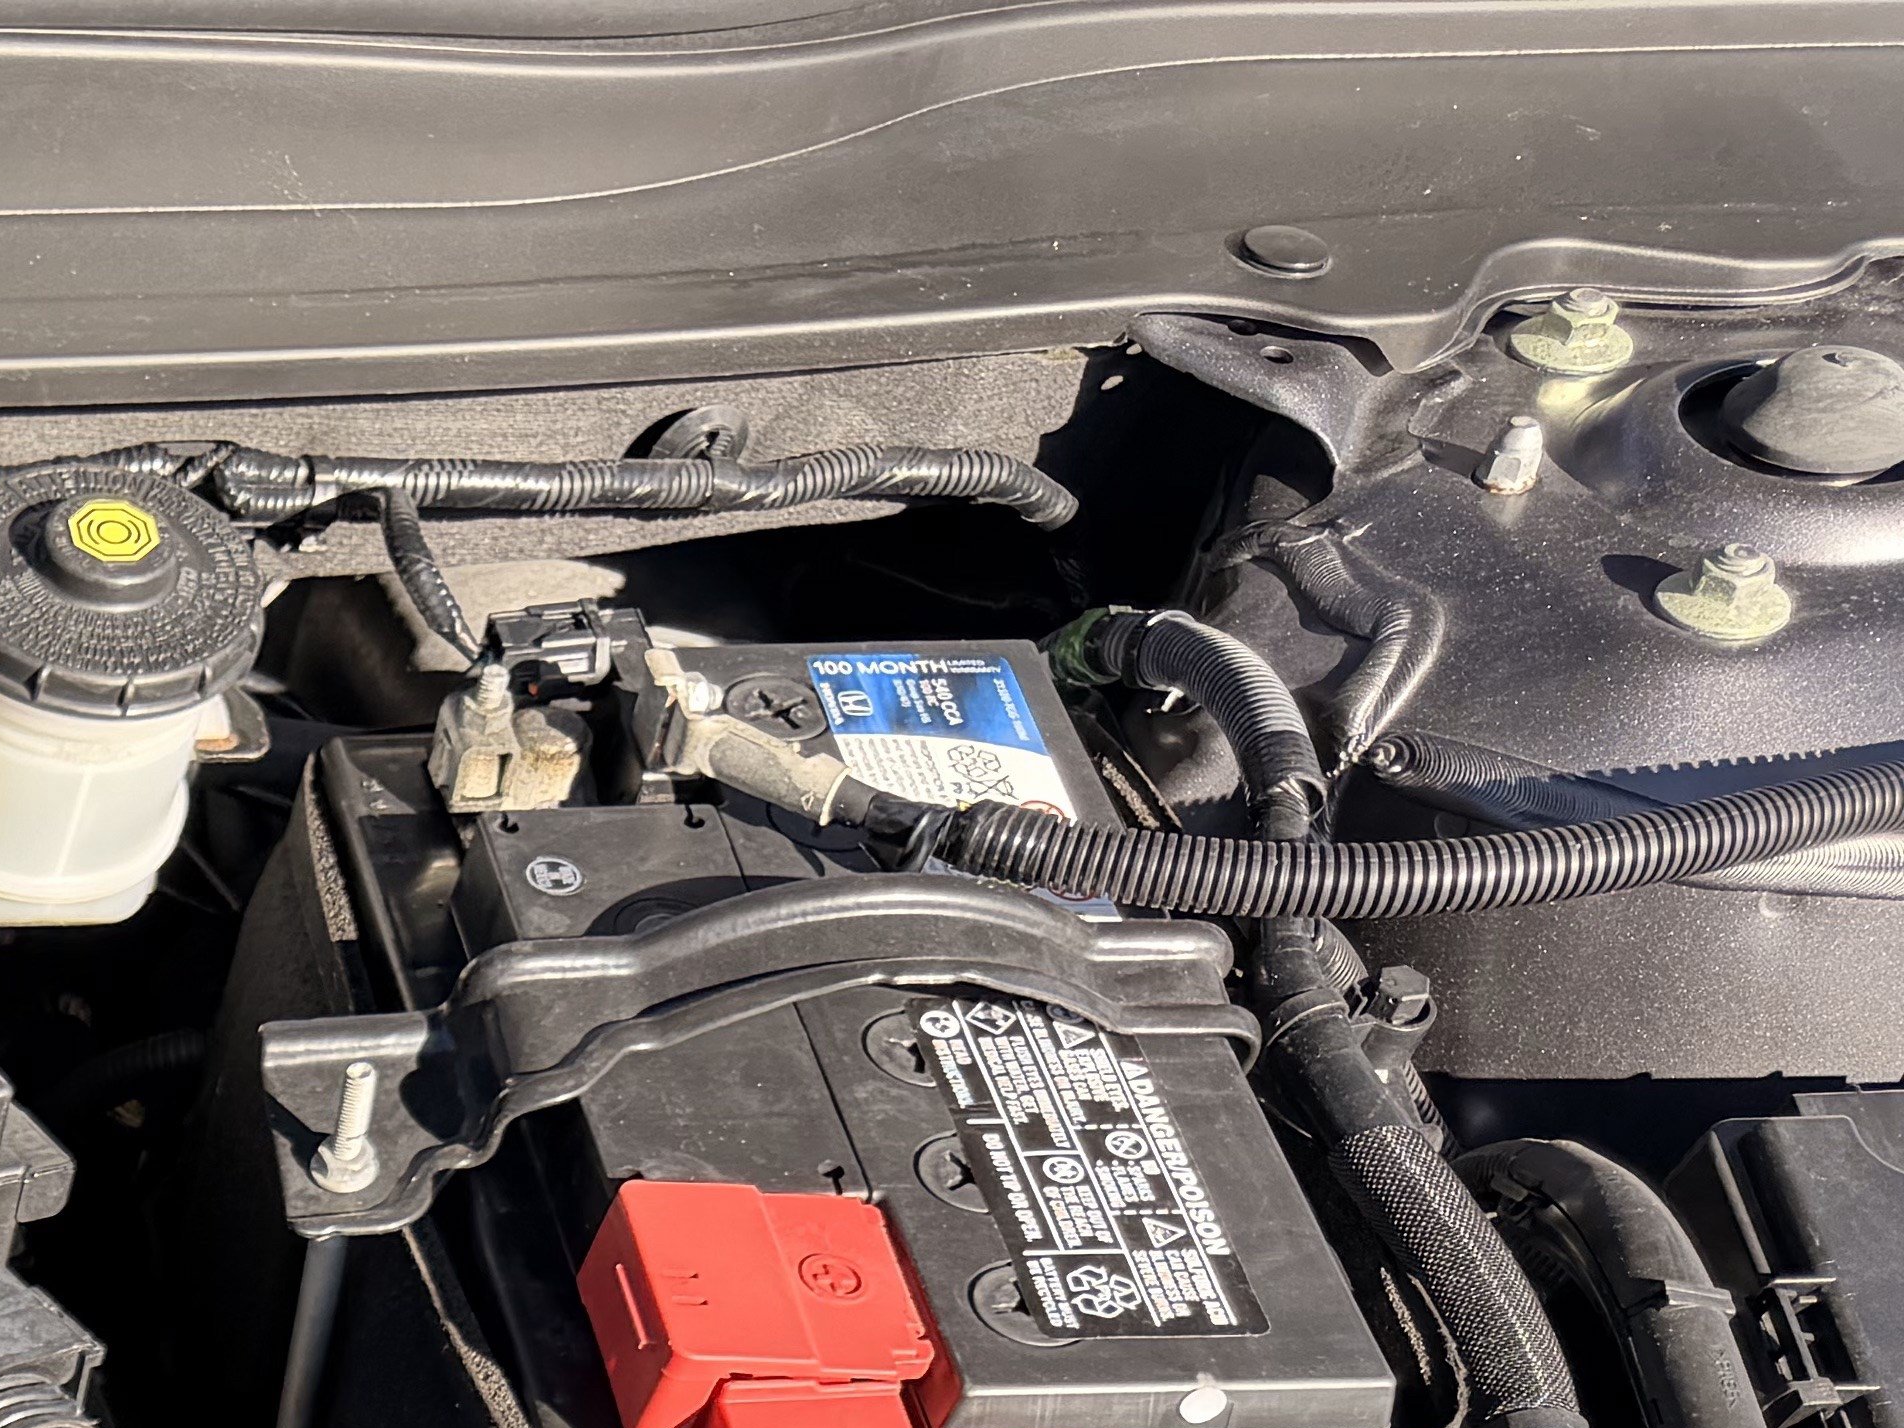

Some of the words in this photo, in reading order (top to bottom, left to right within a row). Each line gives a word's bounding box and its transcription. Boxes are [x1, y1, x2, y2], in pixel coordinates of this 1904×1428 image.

[812, 660, 853, 675] 100
[857, 660, 948, 675] MONTH
[819, 682, 845, 726] HONDA
[1126, 1077, 1231, 1255] DANGER/POISON
